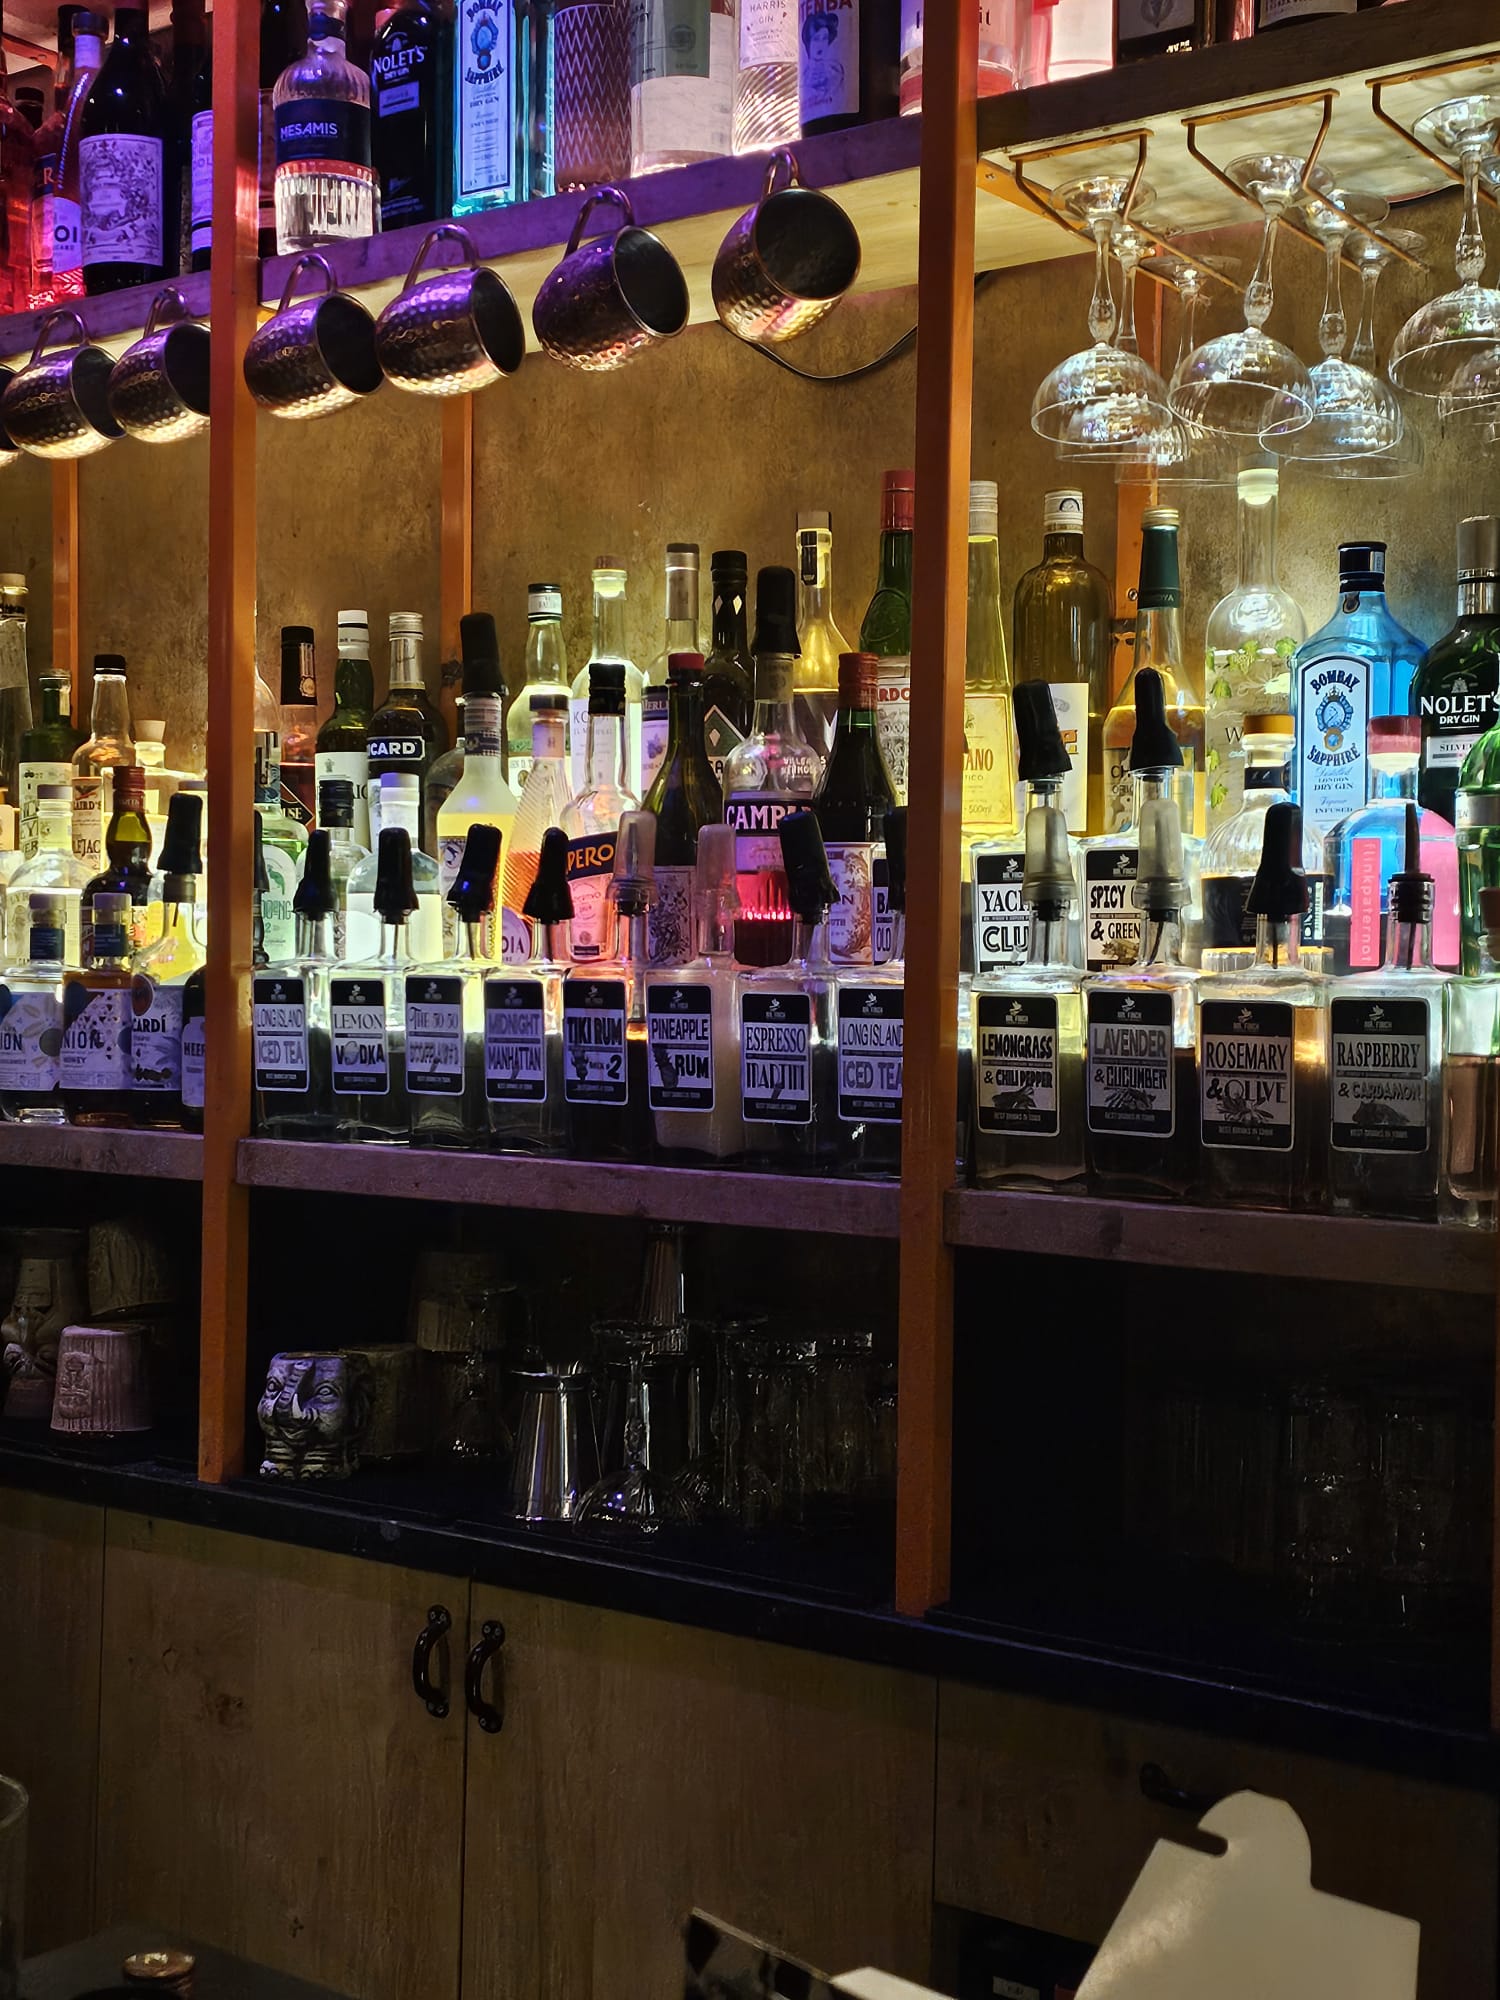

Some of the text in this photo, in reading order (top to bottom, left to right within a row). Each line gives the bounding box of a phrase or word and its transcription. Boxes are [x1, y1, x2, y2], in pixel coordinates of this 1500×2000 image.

[465, 59, 504, 84] SAPPHIRE
[1310, 669, 1360, 695] BOMBAY
[1440, 714, 1480, 725] DRY GIN
[1307, 743, 1360, 766] SAPPHIRE
[1090, 885, 1126, 908] SPICY
[1090, 920, 1104, 941] &
[334, 1013, 383, 1029] LEMON
[489, 1013, 540, 1035] MIDNIGHT
[567, 1017, 622, 1045] TIKI RUM
[652, 1018, 709, 1040] PINEAPPLE
[258, 1040, 304, 1064] ICED TEA
[746, 1027, 806, 1053] ESPRESSO
[982, 1033, 1052, 1059] LEMONGRASS
[1094, 1028, 1166, 1057] LAVENDER
[335, 1041, 385, 1065] VODKA
[488, 1046, 541, 1071] MANHATTAN
[1206, 1042, 1288, 1070] ROSEMARY
[1336, 1042, 1420, 1068] RASPBERRY
[674, 1054, 709, 1078] RUM
[843, 1061, 874, 1089] ICED
[1094, 1066, 1167, 1089] & CUCUMBER
[984, 1071, 994, 1084] &
[1020, 1070, 1053, 1089] PEPPER
[1206, 1078, 1288, 1103] & OLIVE
[1338, 1083, 1350, 1098] &
